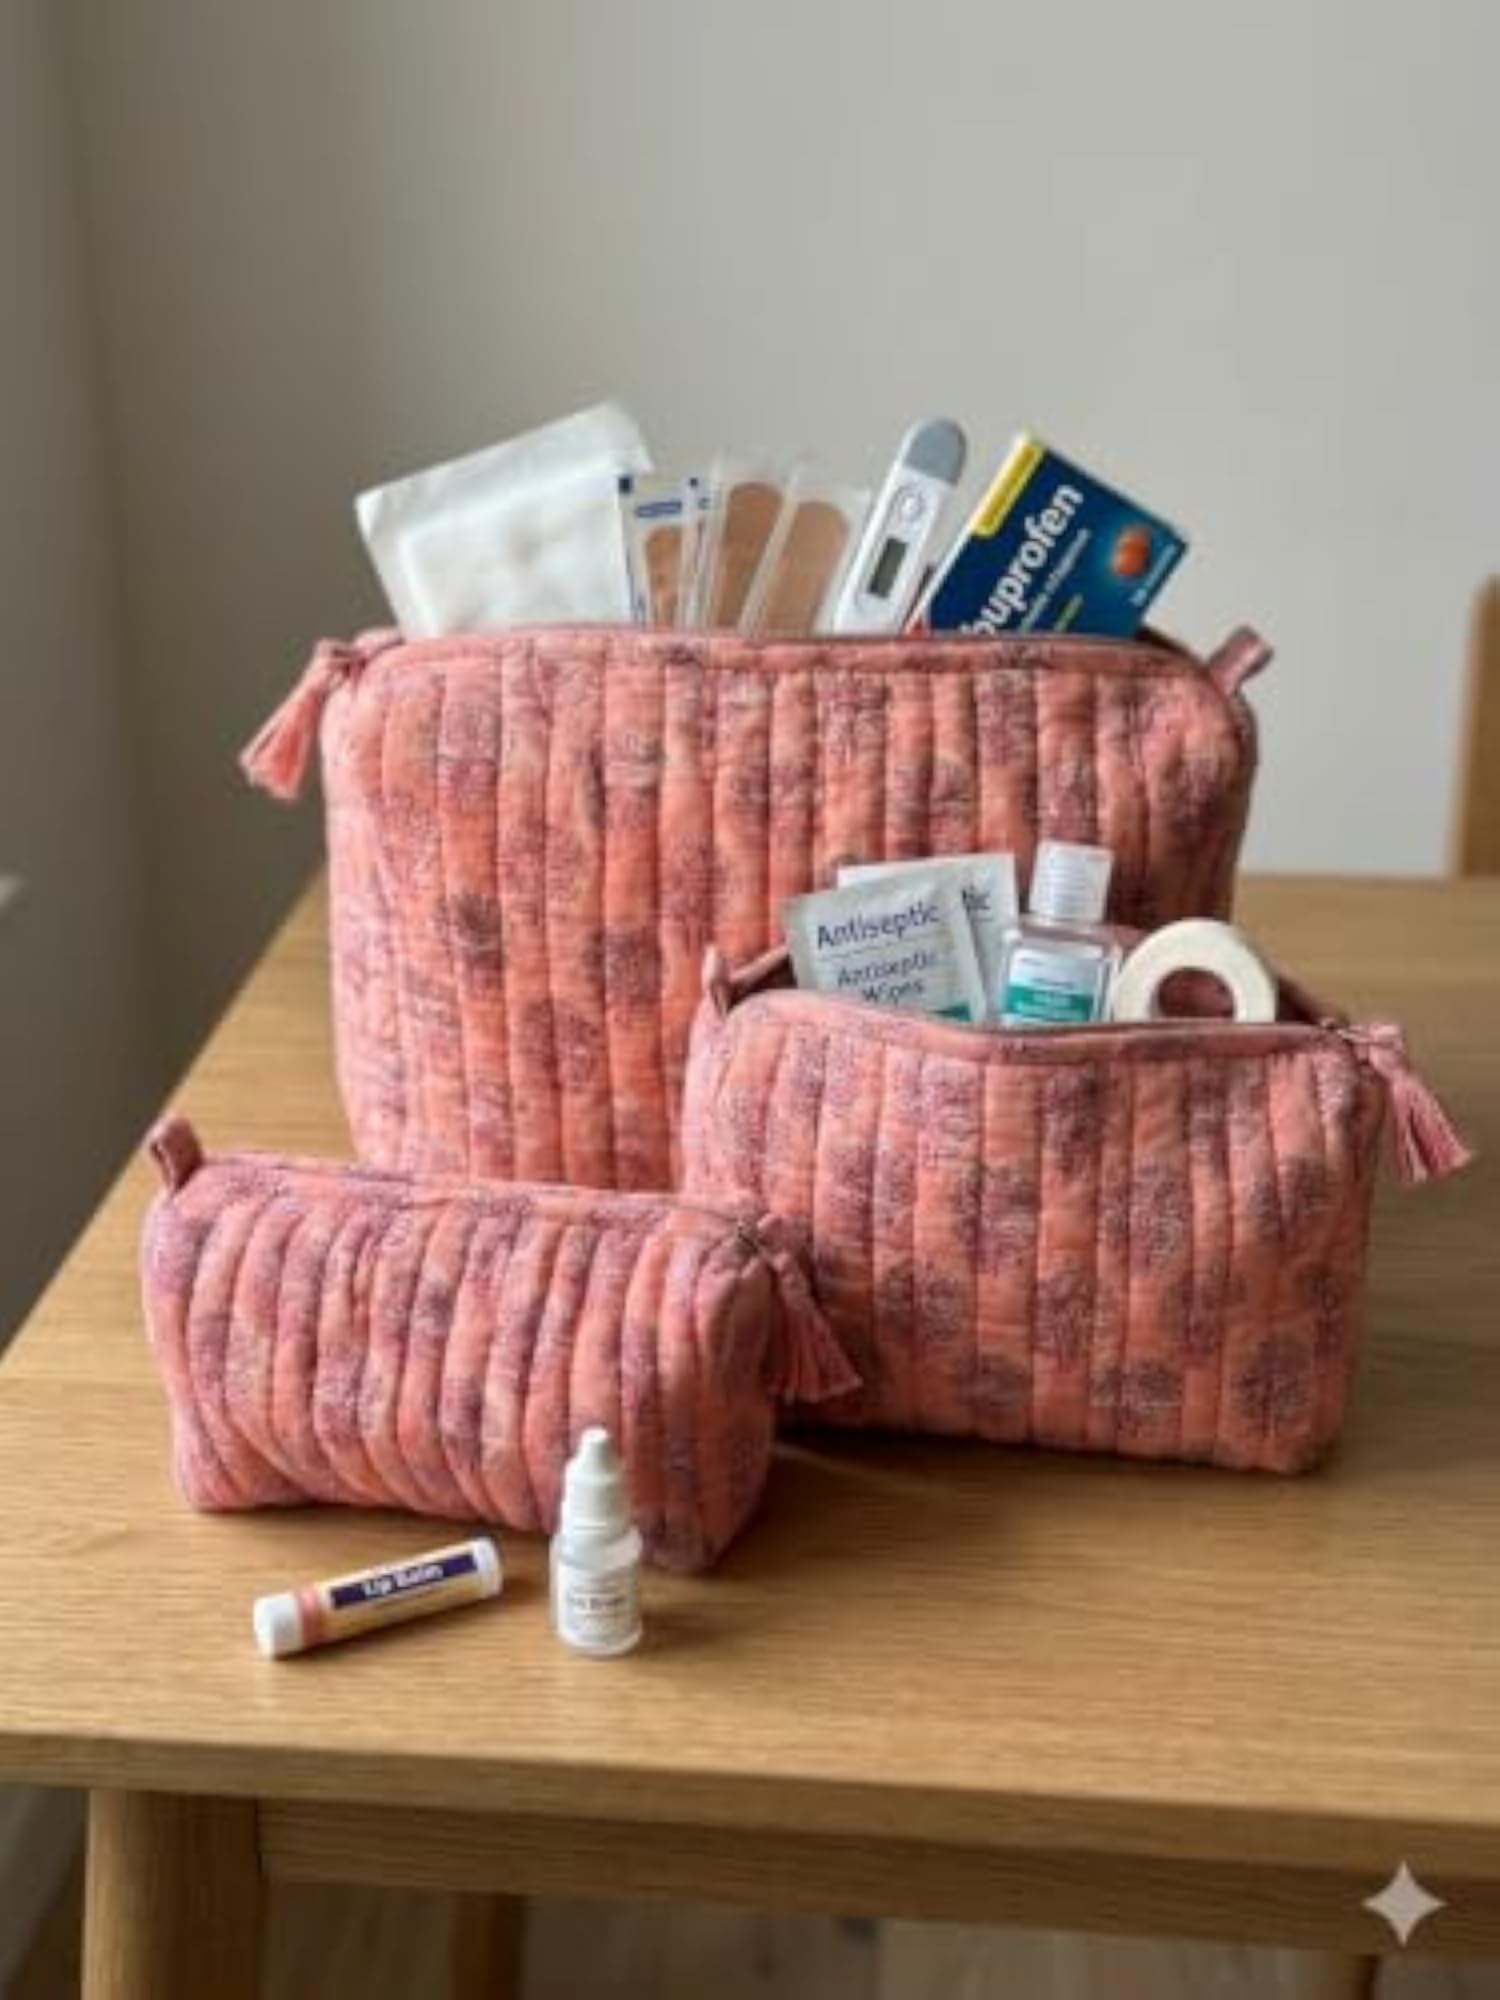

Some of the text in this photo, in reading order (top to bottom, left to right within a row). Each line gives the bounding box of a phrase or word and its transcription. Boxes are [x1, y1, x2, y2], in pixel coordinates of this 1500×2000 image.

[959, 484, 1084, 634] buprofen
[816, 900, 940, 949] Antiseptic
[361, 1578, 392, 1600] Lip
